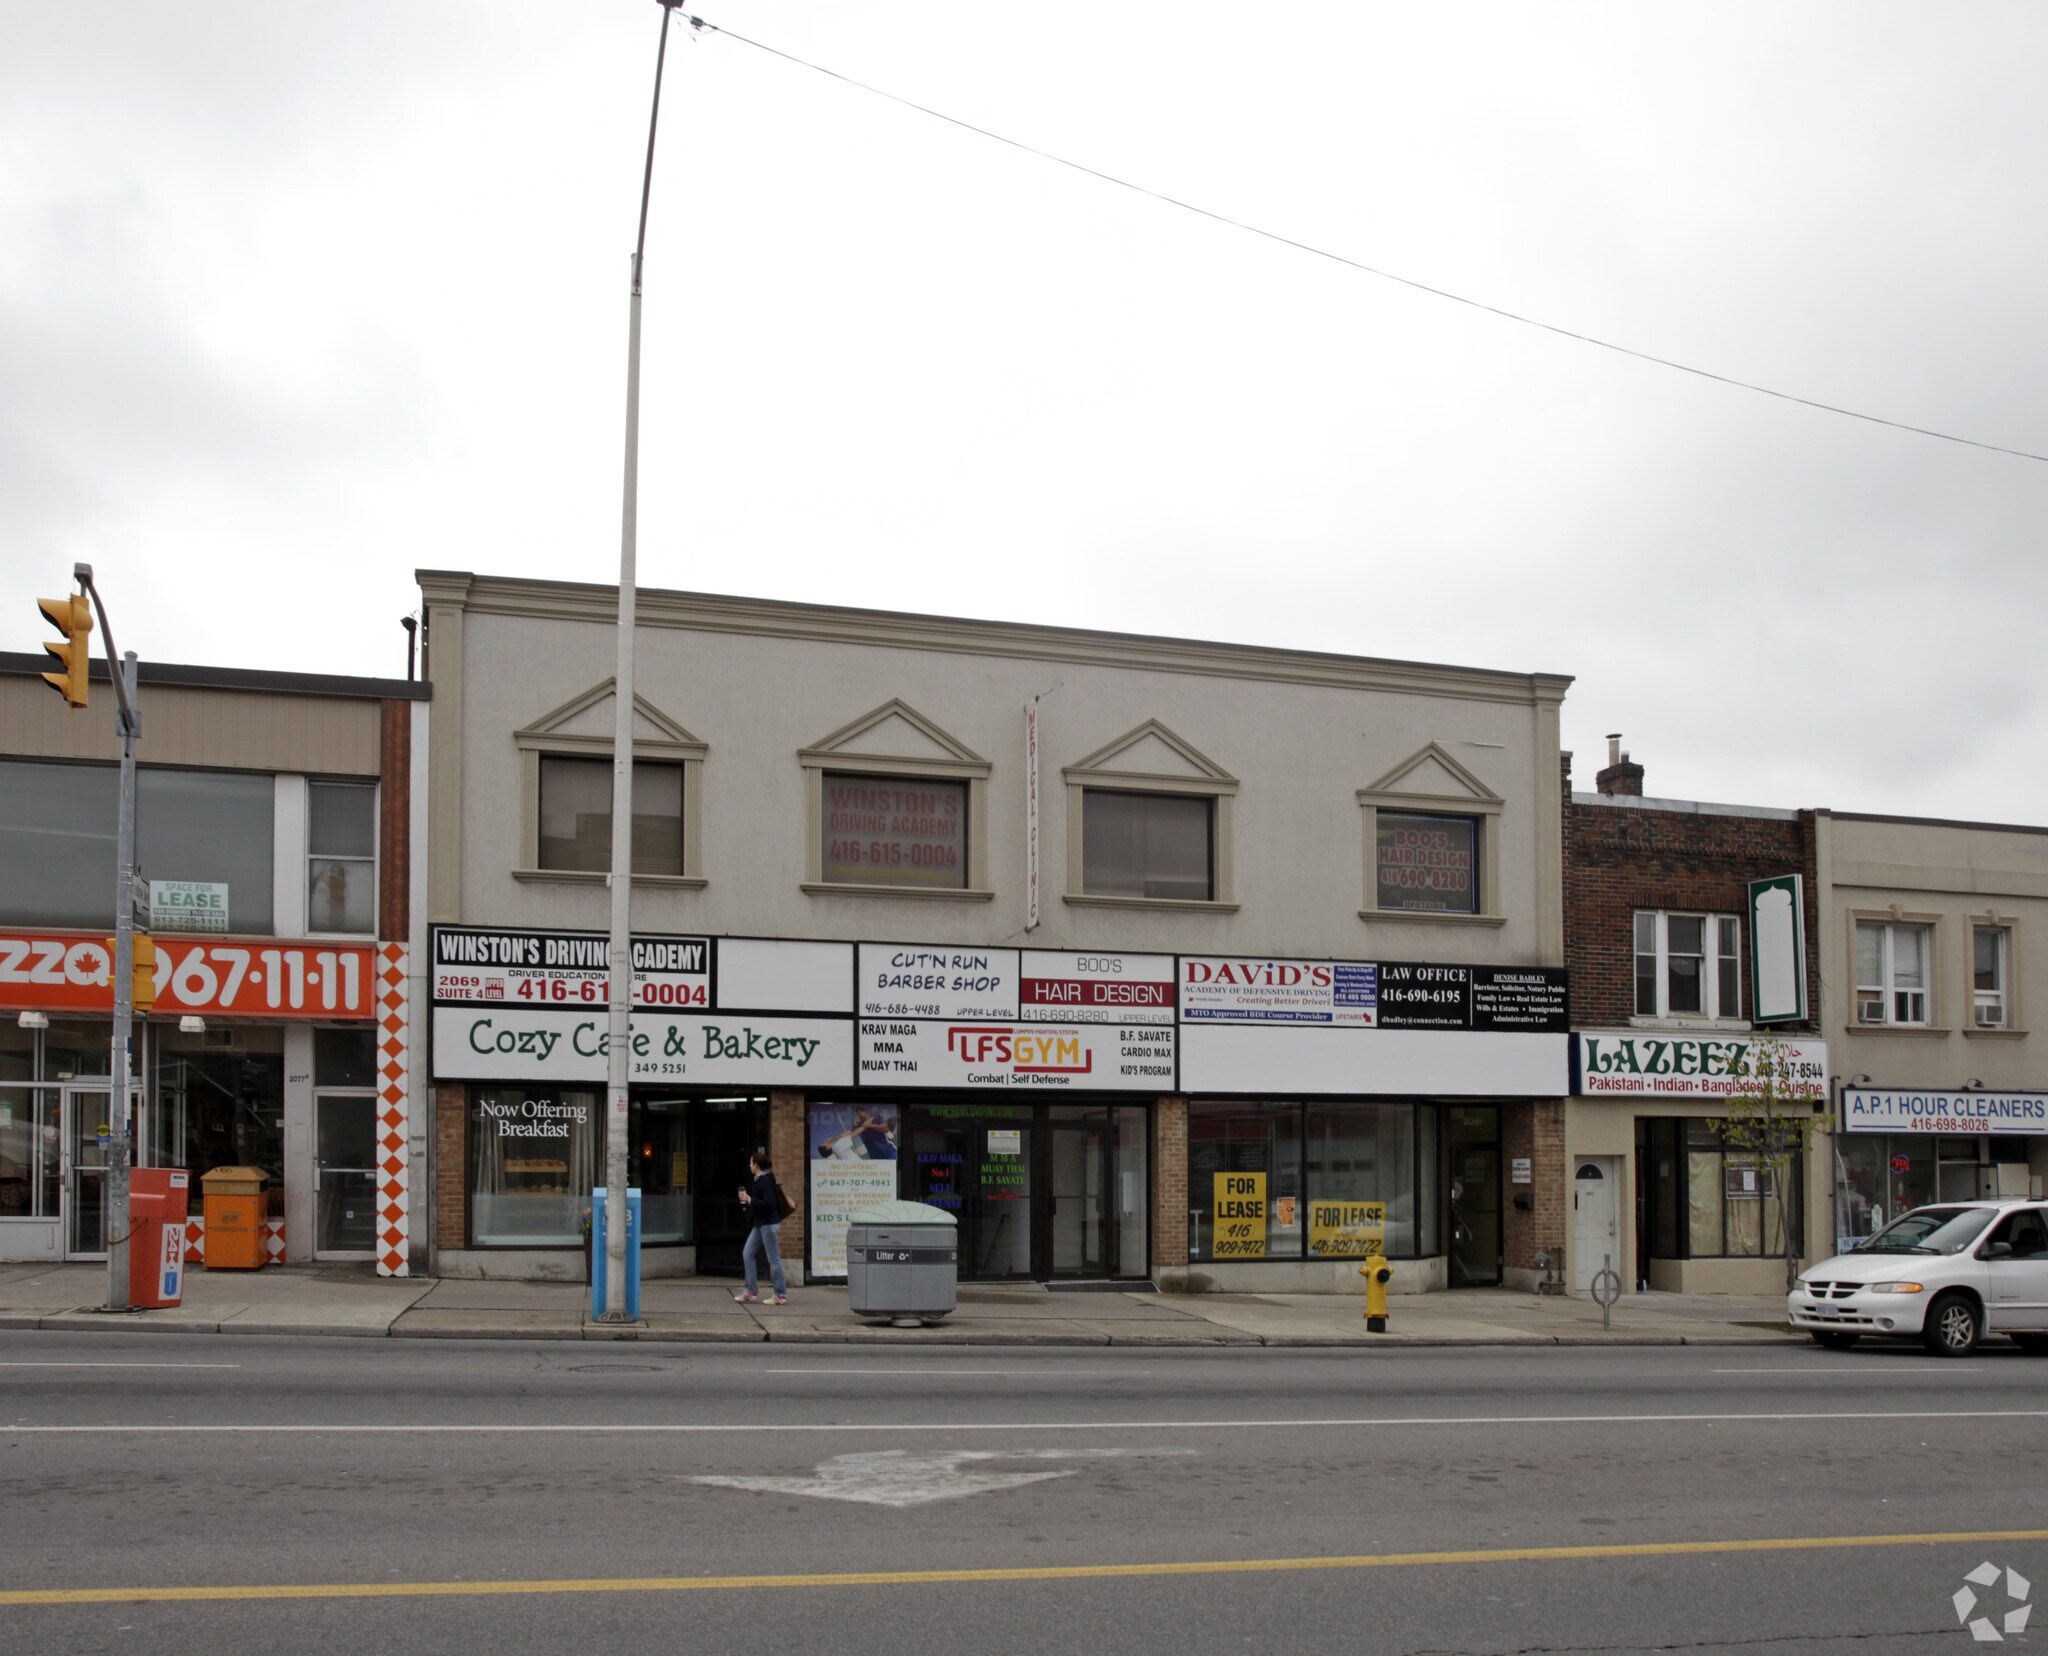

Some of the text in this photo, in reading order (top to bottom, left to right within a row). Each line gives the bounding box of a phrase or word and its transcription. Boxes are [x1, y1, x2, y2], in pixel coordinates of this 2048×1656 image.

[1028, 709, 1036, 817] MEDICAL
[830, 787, 958, 815] WINSTON'S
[831, 812, 957, 836] DRIVING ACADEMY
[1396, 830, 1447, 849] BOO'S
[831, 840, 957, 867] 416-615-0004
[1379, 847, 1468, 869] HAIR DESIGN
[1400, 867, 1427, 888] 690
[1432, 869, 1467, 891] 8280
[165, 883, 212, 892] SPACE FOR
[158, 892, 221, 908] LEASE
[154, 916, 225, 925] 613-725-1111
[440, 935, 540, 964] WINSTON'S
[630, 942, 703, 970] CADEMY
[952, 955, 987, 970] RUN
[1077, 957, 1122, 973] BOO'S
[508, 970, 606, 980] DRIVER EDUCATION
[1382, 967, 1467, 981] LAW OFFICE
[1493, 974, 1546, 983] DENISE BADLEY
[439, 976, 480, 987] 2069
[878, 974, 1001, 992] BARBER SHOP
[437, 988, 483, 999] SUITE 4
[486, 990, 503, 998] LEVEL
[517, 979, 707, 1005] 416-61-0004
[1035, 982, 1163, 1004] HAIR DESIGN
[1184, 986, 1227, 994] ACADEMY
[1243, 988, 1292, 996] DEFENSIVE
[1527, 985, 1546, 993] Notary
[1381, 988, 1461, 1003] 416-690-6195
[1477, 994, 1497, 1002] Family
[1237, 997, 1331, 1006] Creating Better Drivers
[865, 1003, 1014, 1017] 416-686-4488 UPPER LEVEL
[1191, 1009, 1209, 1017] MTO
[1211, 1010, 1248, 1018] Approved
[1528, 1006, 1564, 1014] Immigration
[1023, 1009, 1172, 1023] 416-690-8280 UPPER LEVEL
[1492, 1015, 1534, 1023] Administrative
[862, 1024, 917, 1036] KRAV MAGA
[1120, 1031, 1171, 1042] B.F. SAVATE
[469, 1019, 820, 1067] Cozy Cae & Bakery
[874, 1042, 904, 1053] MMA
[1121, 1047, 1171, 1058] CARDIO MAX
[1585, 1038, 1750, 1076] LAZEEZ
[634, 1063, 686, 1074] 349 5251
[861, 1060, 917, 1071] MUAY THAI
[1120, 1065, 1171, 1076] KID'S PROGRAM
[967, 1073, 1070, 1084] Combat Self Defense
[1589, 1076, 1644, 1091] Pakistani
[1653, 1078, 1693, 1092] Indian
[479, 1100, 587, 1123] Now Offering
[1899, 1097, 1949, 1116] HOUR
[1954, 1098, 2045, 1118] CLEANERS
[498, 1119, 569, 1138] Breakfast
[1910, 1117, 1989, 1131] 416-698-8026
[917, 1153, 963, 1163] KRAV MAGA
[931, 1168, 950, 1177] No.1
[981, 1164, 1025, 1173] MUAY THAI
[829, 1179, 891, 1187] 647-707-4941
[996, 1176, 1025, 1184] SAVATE
[929, 1184, 951, 1192] SELF
[1227, 1178, 1256, 1194] FOR
[1218, 1201, 1263, 1218] LEASE
[816, 1214, 842, 1222] KID'S
[1315, 1207, 1382, 1227] FOR LEASE
[876, 1250, 894, 1260] Litter
